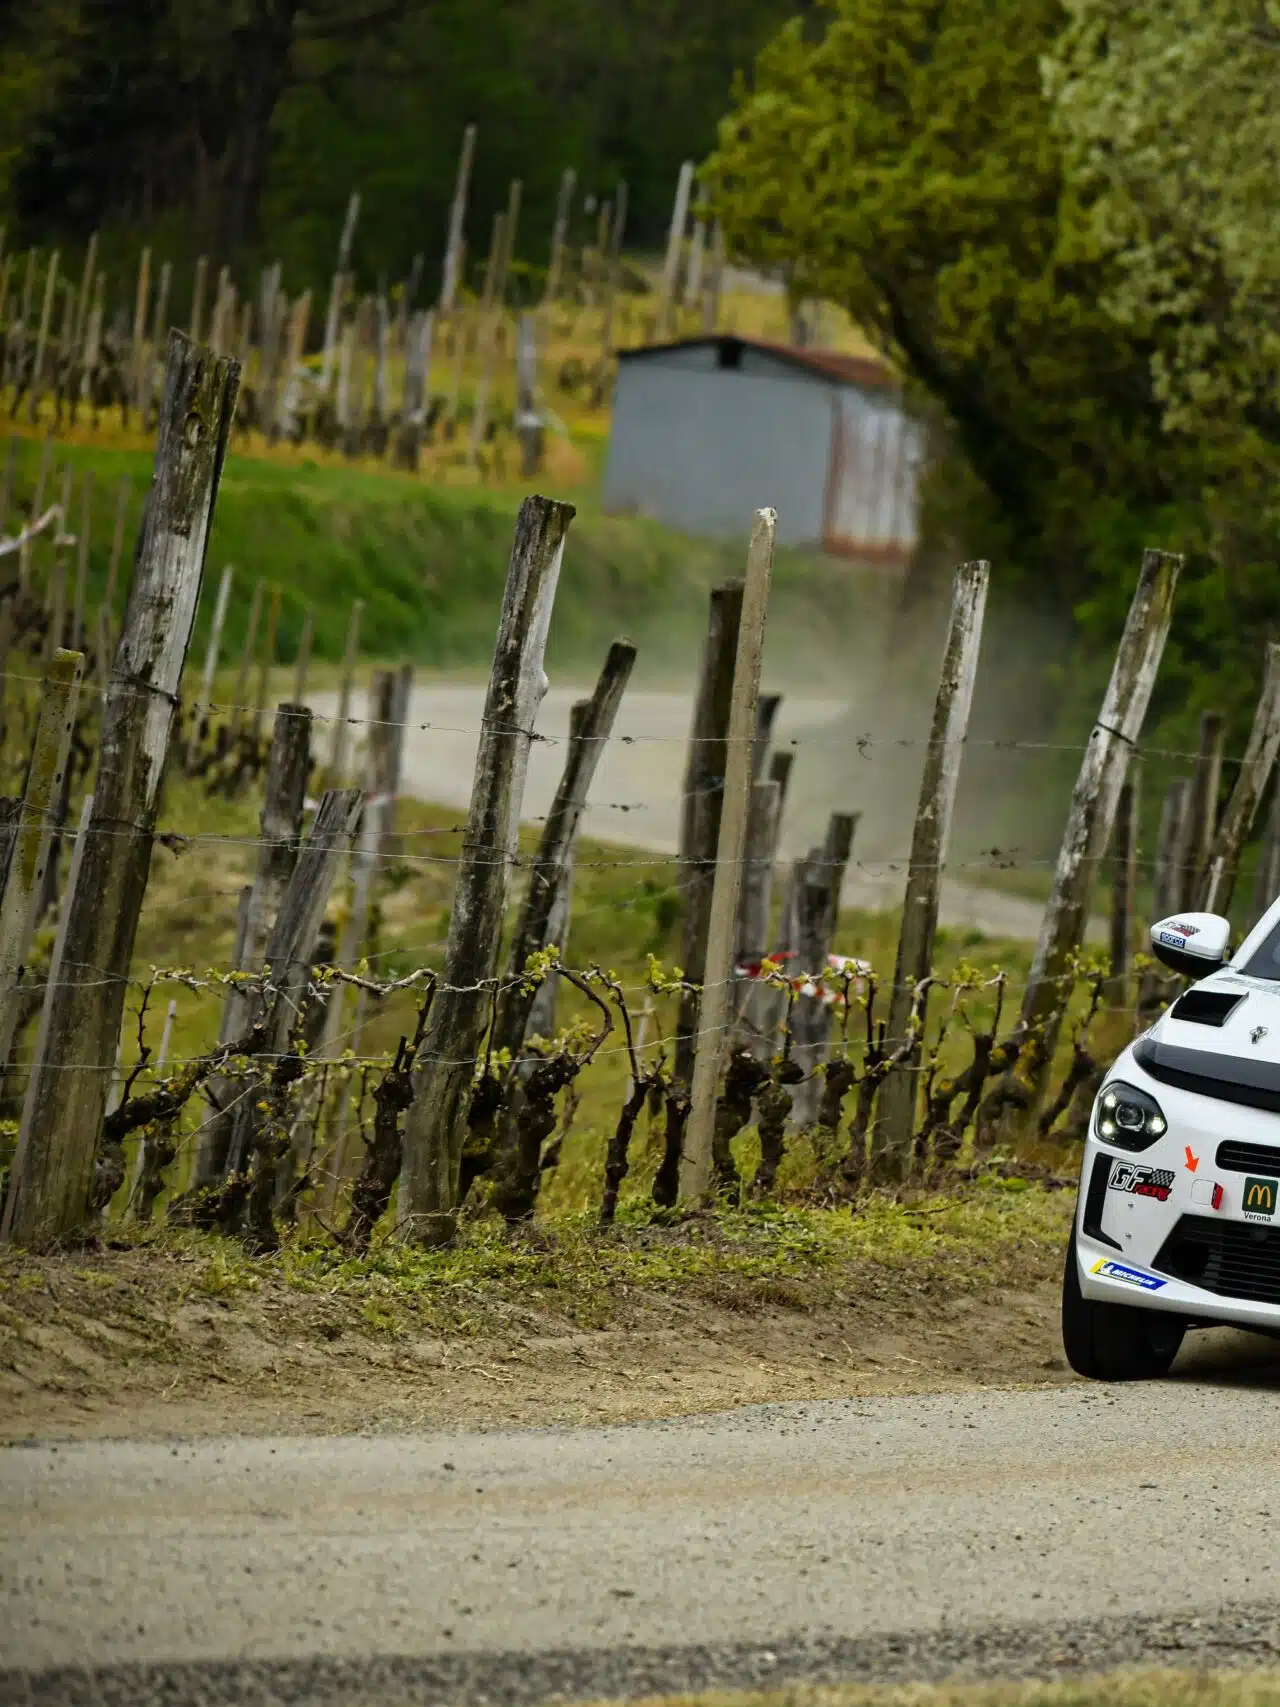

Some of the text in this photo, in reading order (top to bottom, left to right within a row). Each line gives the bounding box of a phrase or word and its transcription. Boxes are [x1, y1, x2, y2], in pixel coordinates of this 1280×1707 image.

[1161, 933, 1184, 948] sparco
[1108, 1161, 1153, 1192] GF
[1244, 1211, 1272, 1222] Verona
[1112, 1269, 1156, 1286] MICHELIN
